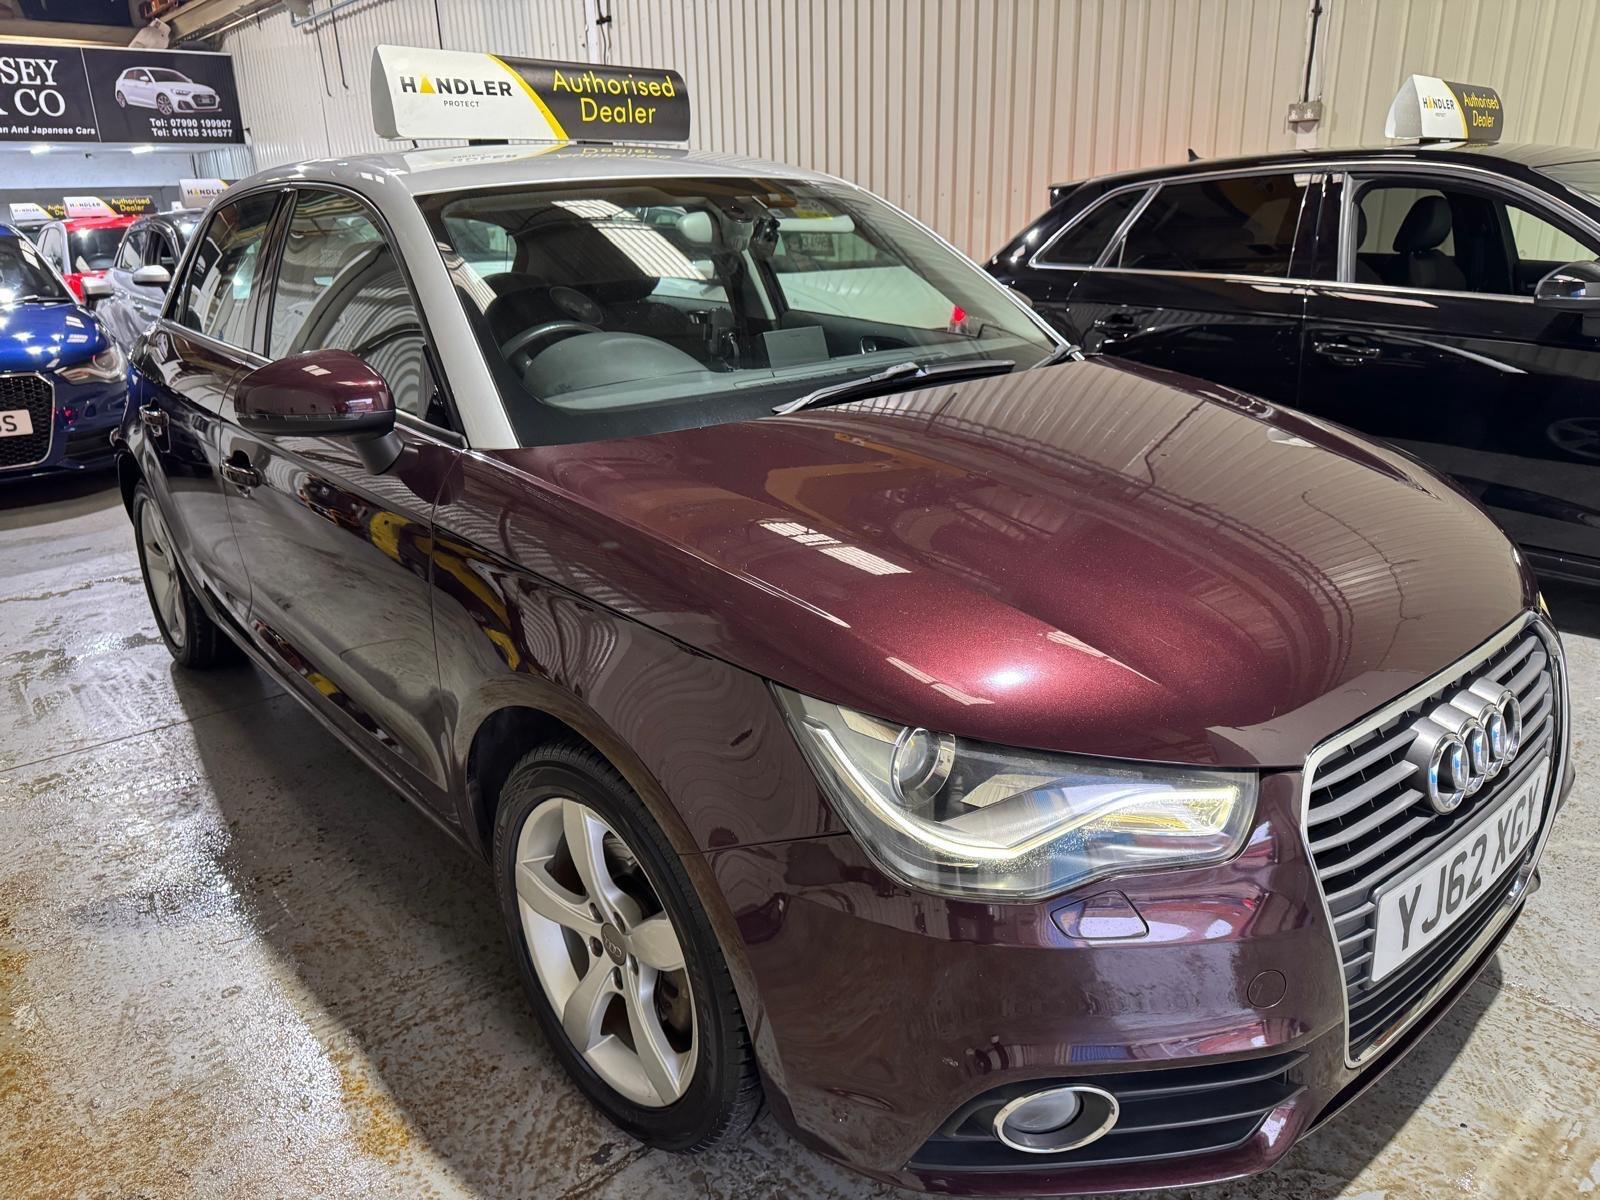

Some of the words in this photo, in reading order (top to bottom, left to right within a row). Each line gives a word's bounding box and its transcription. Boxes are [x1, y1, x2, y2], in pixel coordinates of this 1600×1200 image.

[0, 57, 58, 86] SEY
[401, 74, 513, 97] HANDLER
[552, 70, 676, 97] Authorised
[14, 88, 66, 117] CO
[443, 99, 480, 108] PROTECT
[581, 97, 656, 124] Dealer
[1423, 96, 1455, 110] HANDLER
[1463, 91, 1500, 110] Authorised
[11, 125, 29, 134] And
[31, 125, 73, 135] Japanese
[75, 126, 96, 135] Cars
[1472, 110, 1495, 128] Dealer
[1398, 833, 1488, 951] YJ62
[1490, 778, 1540, 876] XGY
